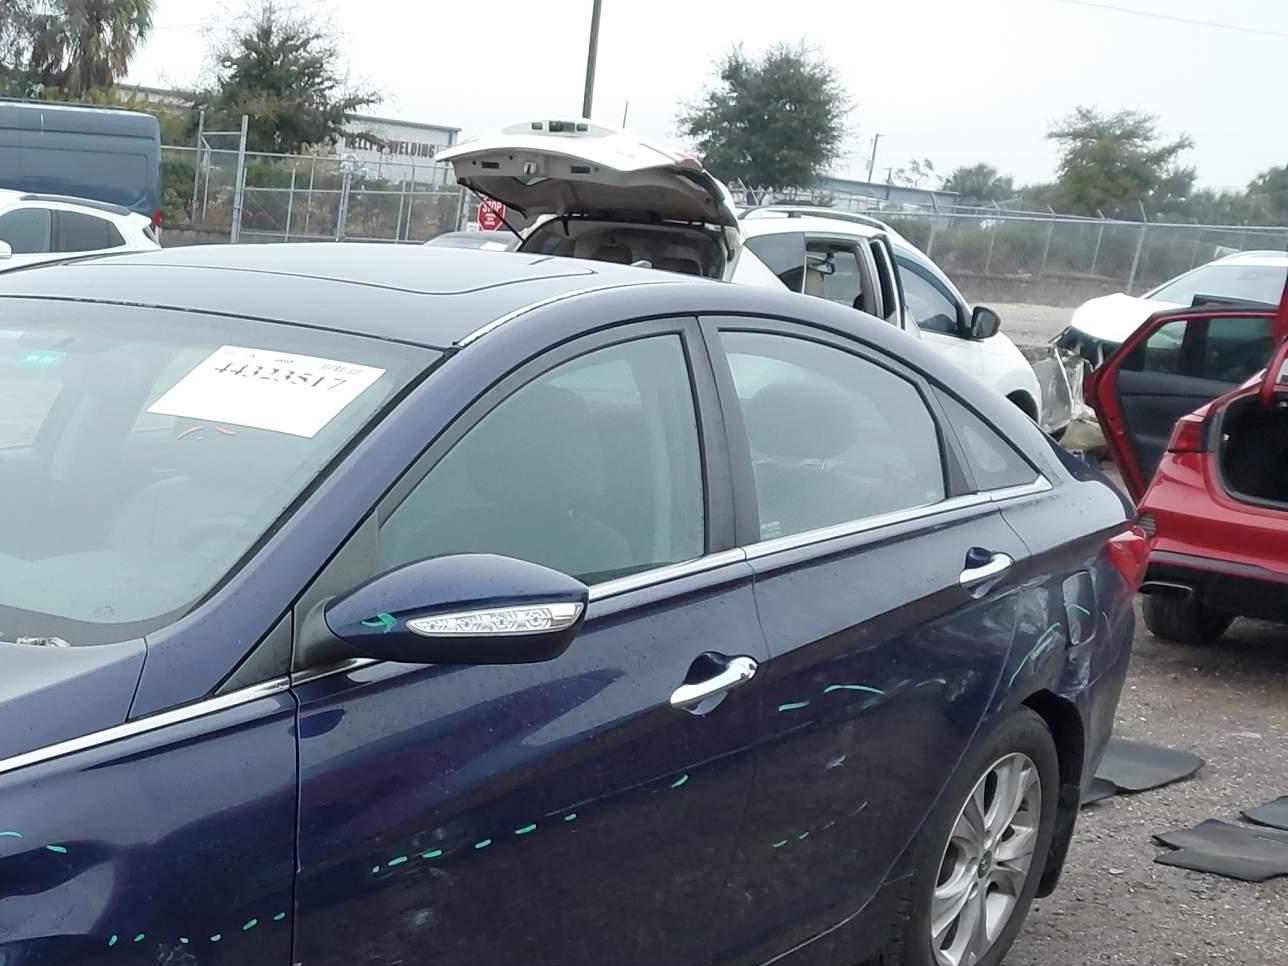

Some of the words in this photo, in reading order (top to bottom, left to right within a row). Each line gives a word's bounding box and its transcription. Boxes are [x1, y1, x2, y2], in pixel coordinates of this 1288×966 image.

[345, 137, 383, 152] KELLYS
[390, 140, 435, 158] WELDING
[482, 200, 502, 213] STOP
